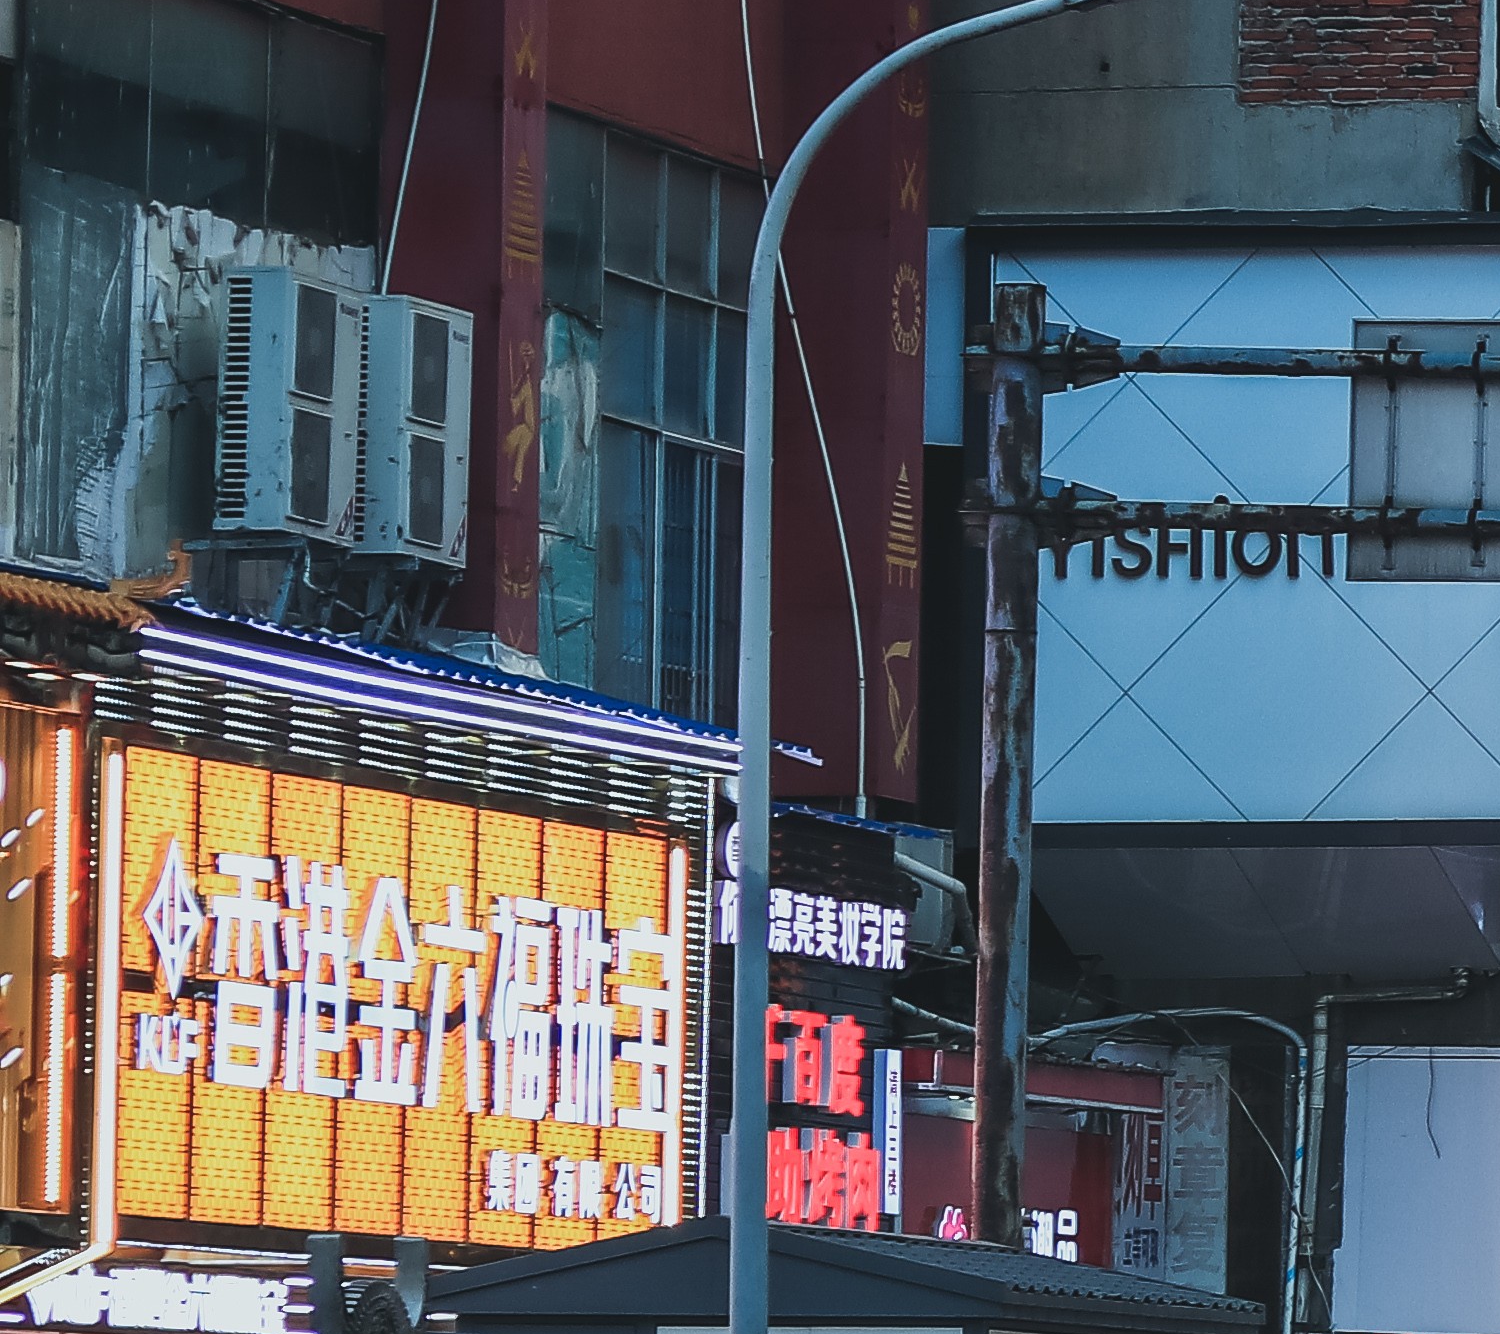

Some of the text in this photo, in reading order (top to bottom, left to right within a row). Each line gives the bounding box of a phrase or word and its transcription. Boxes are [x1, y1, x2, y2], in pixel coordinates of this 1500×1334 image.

[211, 853, 672, 1133] 香港金六福珠宝
[488, 1150, 663, 1223] 集团有限公司
